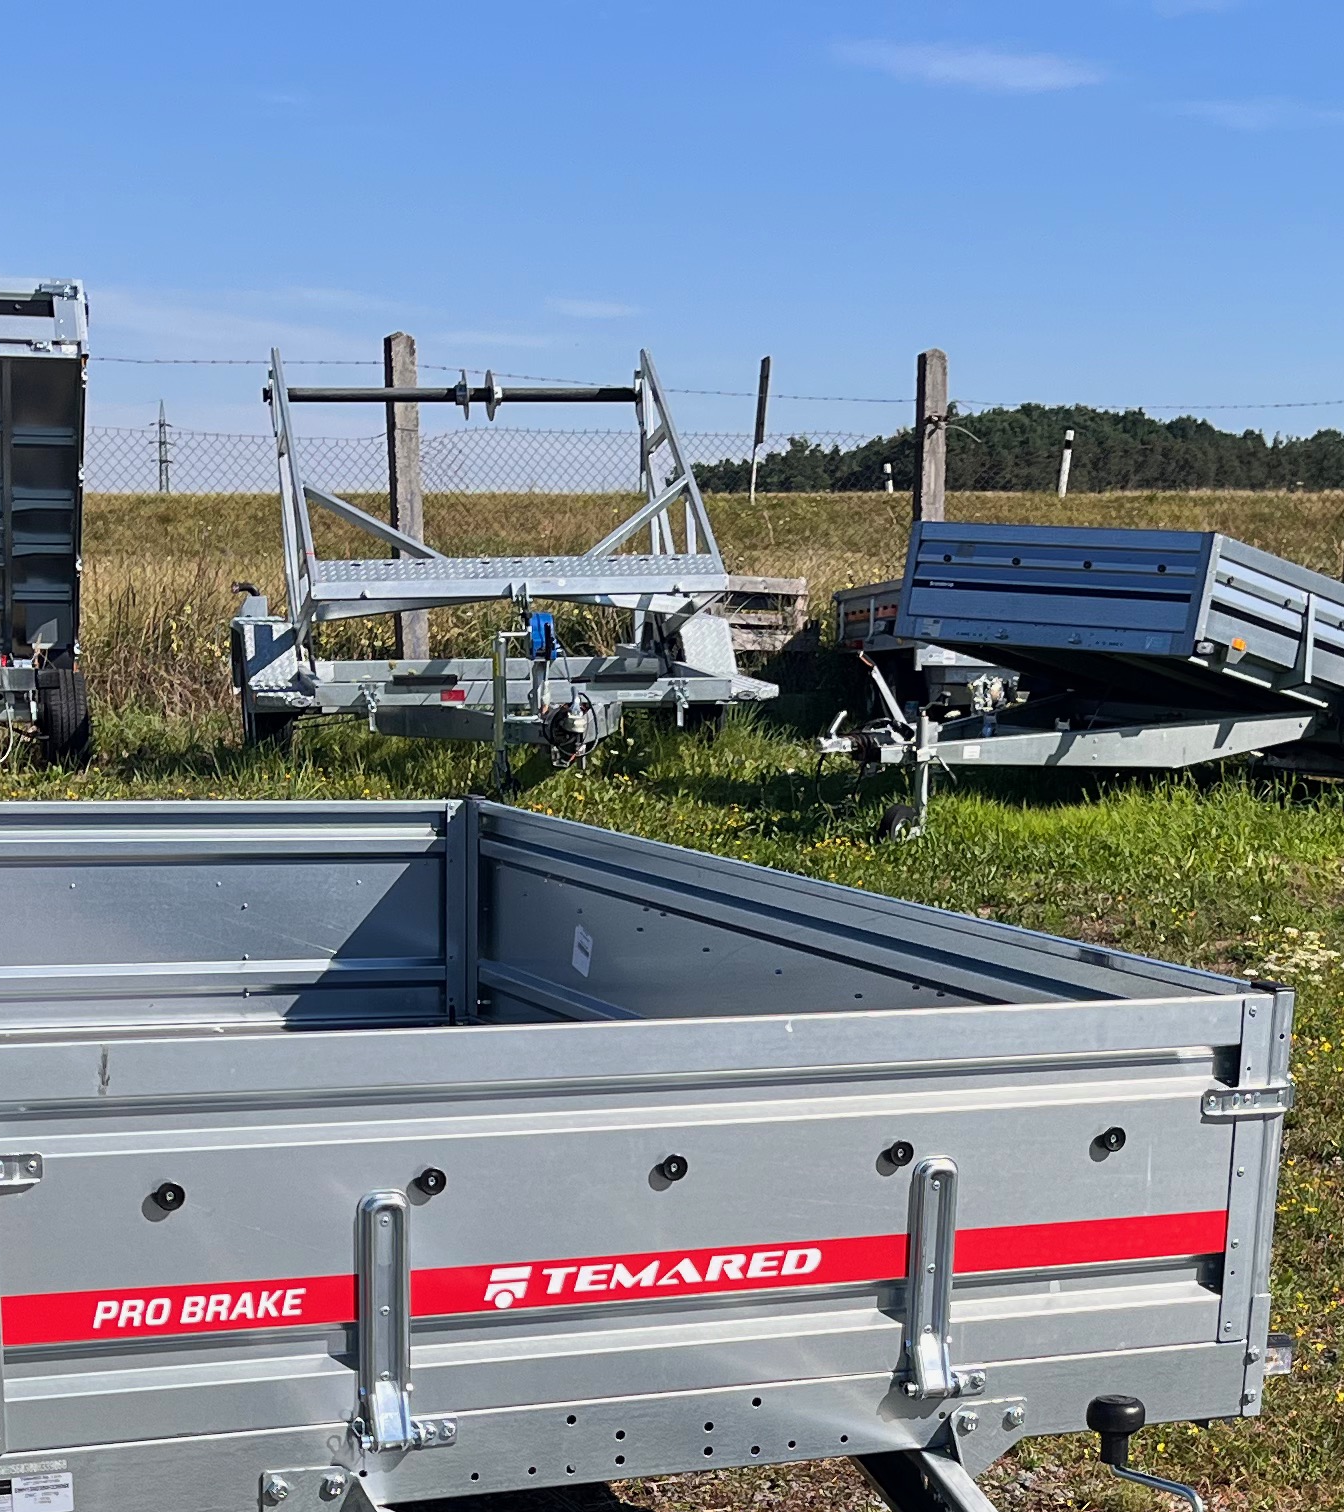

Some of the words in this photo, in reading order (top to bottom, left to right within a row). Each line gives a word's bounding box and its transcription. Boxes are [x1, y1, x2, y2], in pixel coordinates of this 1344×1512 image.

[542, 1248, 822, 1295] TEMARED
[92, 1298, 172, 1329] PRO
[180, 1288, 306, 1324] BRAKE
